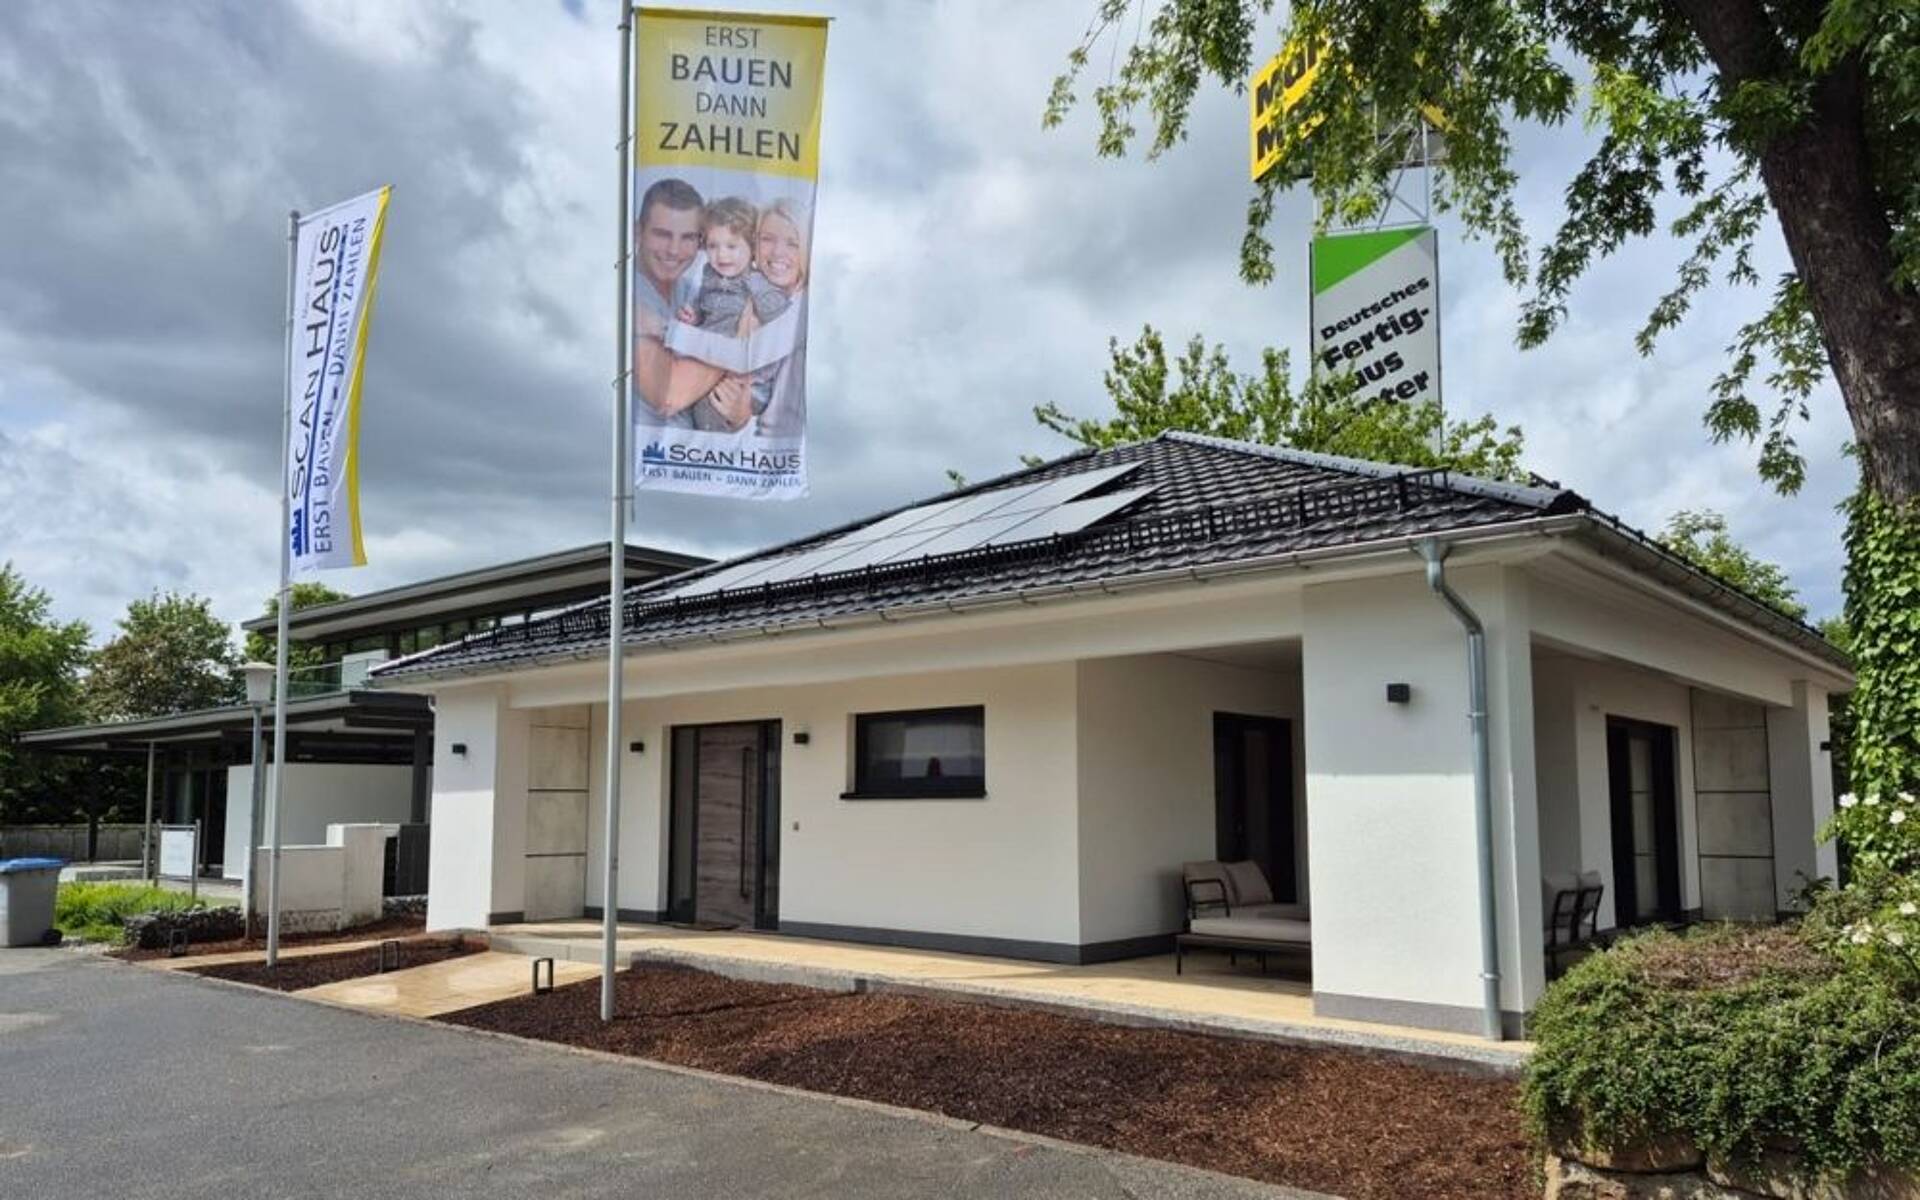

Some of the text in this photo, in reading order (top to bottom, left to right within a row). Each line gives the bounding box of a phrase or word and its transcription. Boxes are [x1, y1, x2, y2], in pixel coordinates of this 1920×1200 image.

[706, 25, 761, 49] ERST
[671, 54, 792, 89] BAUEN
[696, 92, 767, 118] DANN
[659, 122, 800, 162] ZAHLEN
[1320, 276, 1430, 340] Deutsches
[1321, 306, 1430, 370] Fertig-
[291, 369, 321, 499] SCAN
[306, 225, 342, 358] HAUS
[314, 501, 332, 553] ERST
[342, 217, 367, 301] ZAHLEN
[669, 444, 801, 469] SCAN HAUS
